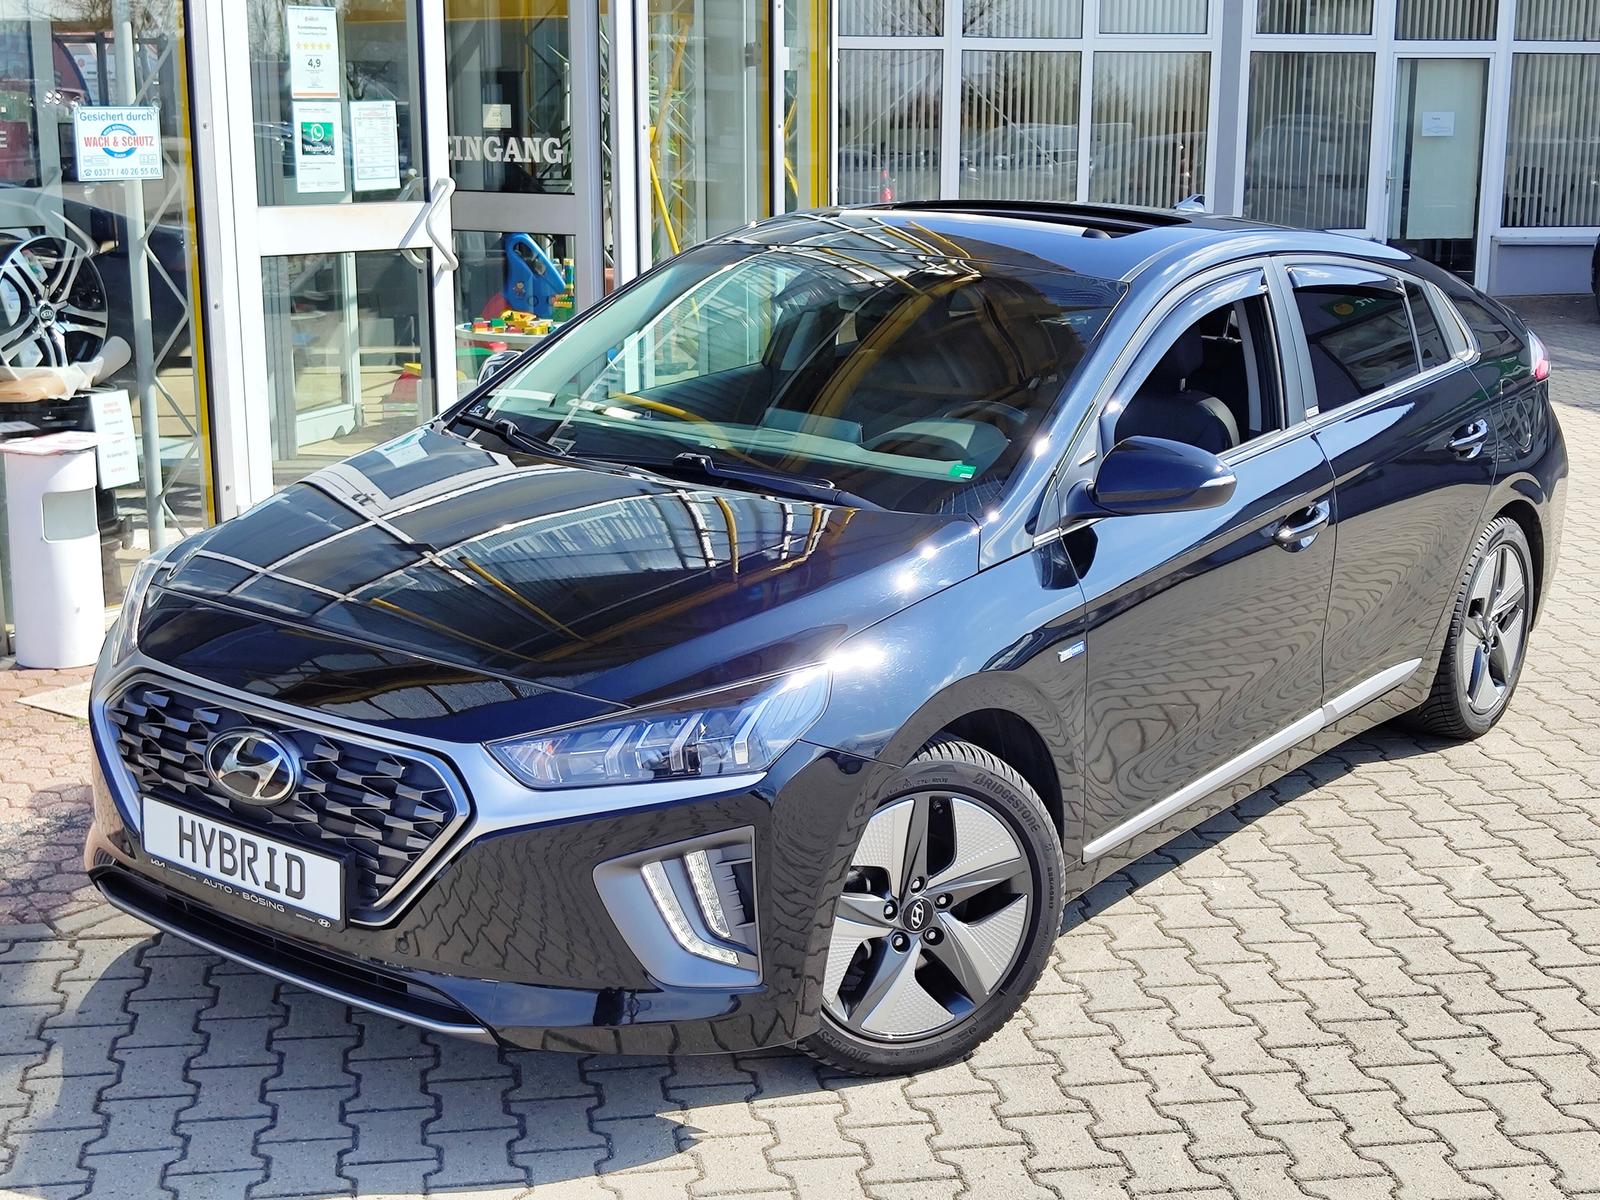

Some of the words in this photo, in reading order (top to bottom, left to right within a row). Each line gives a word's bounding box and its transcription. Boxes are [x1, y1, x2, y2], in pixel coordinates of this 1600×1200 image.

[308, 58, 321, 69] 4,9
[80, 111, 123, 121] Gesichert
[84, 136, 110, 147] WACH
[113, 136, 119, 147] &
[122, 136, 154, 147] SCHUTZ
[303, 144, 333, 153] WhatsApp
[94, 168, 114, 176] 03371
[972, 772, 1041, 833] BRIDGESTONE
[178, 815, 306, 900] HYBRID
[203, 878, 232, 894] AUTO
